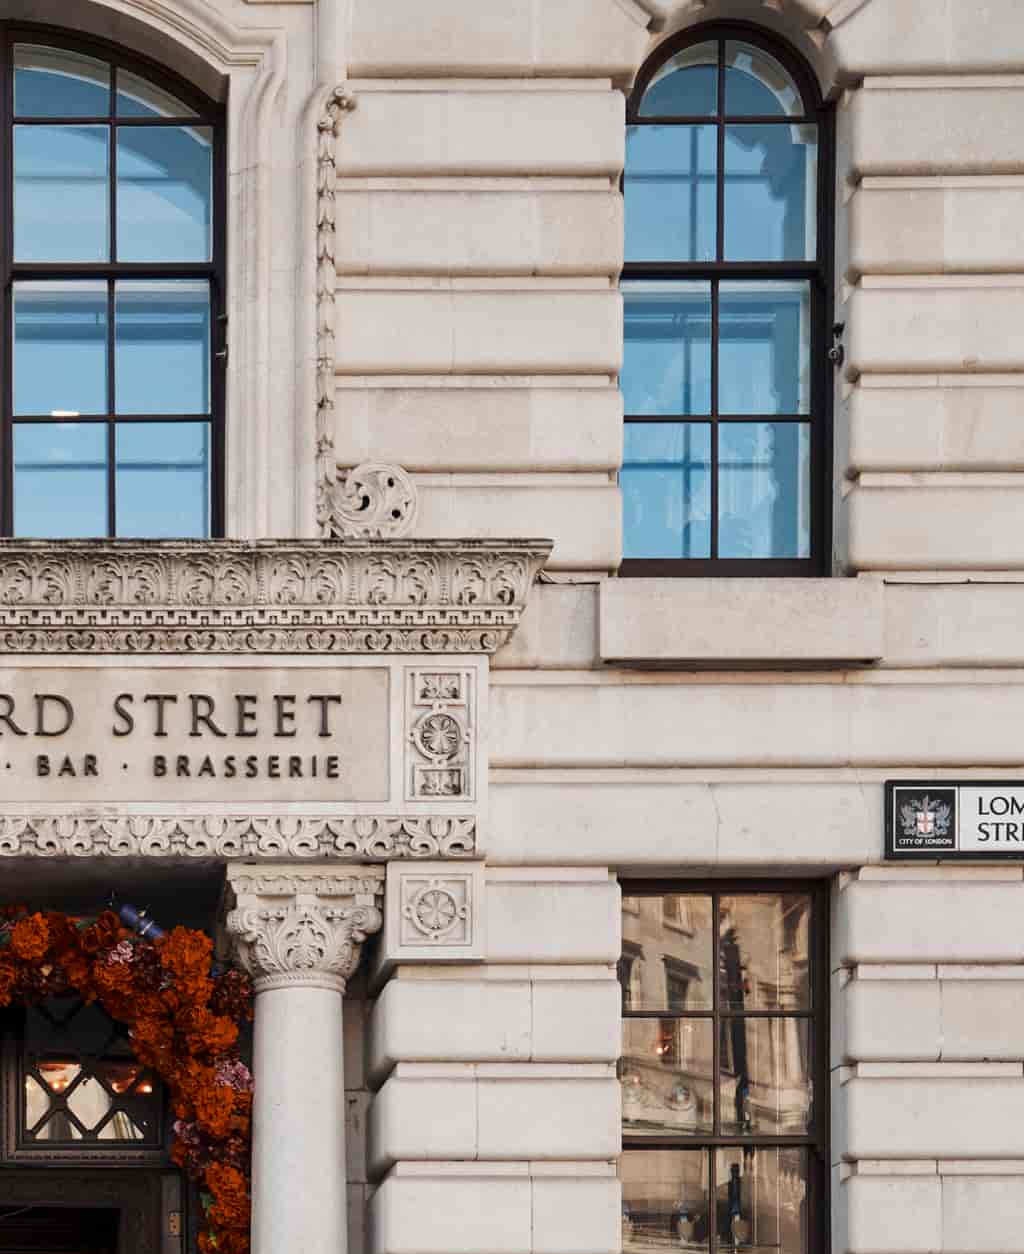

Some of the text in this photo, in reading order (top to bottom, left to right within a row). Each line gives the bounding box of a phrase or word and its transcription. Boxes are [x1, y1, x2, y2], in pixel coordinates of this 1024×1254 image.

[112, 693, 343, 738] STREET
[36, 754, 100, 778] BAR
[152, 755, 341, 779] BRASSERIE
[977, 822, 1024, 841] STR
